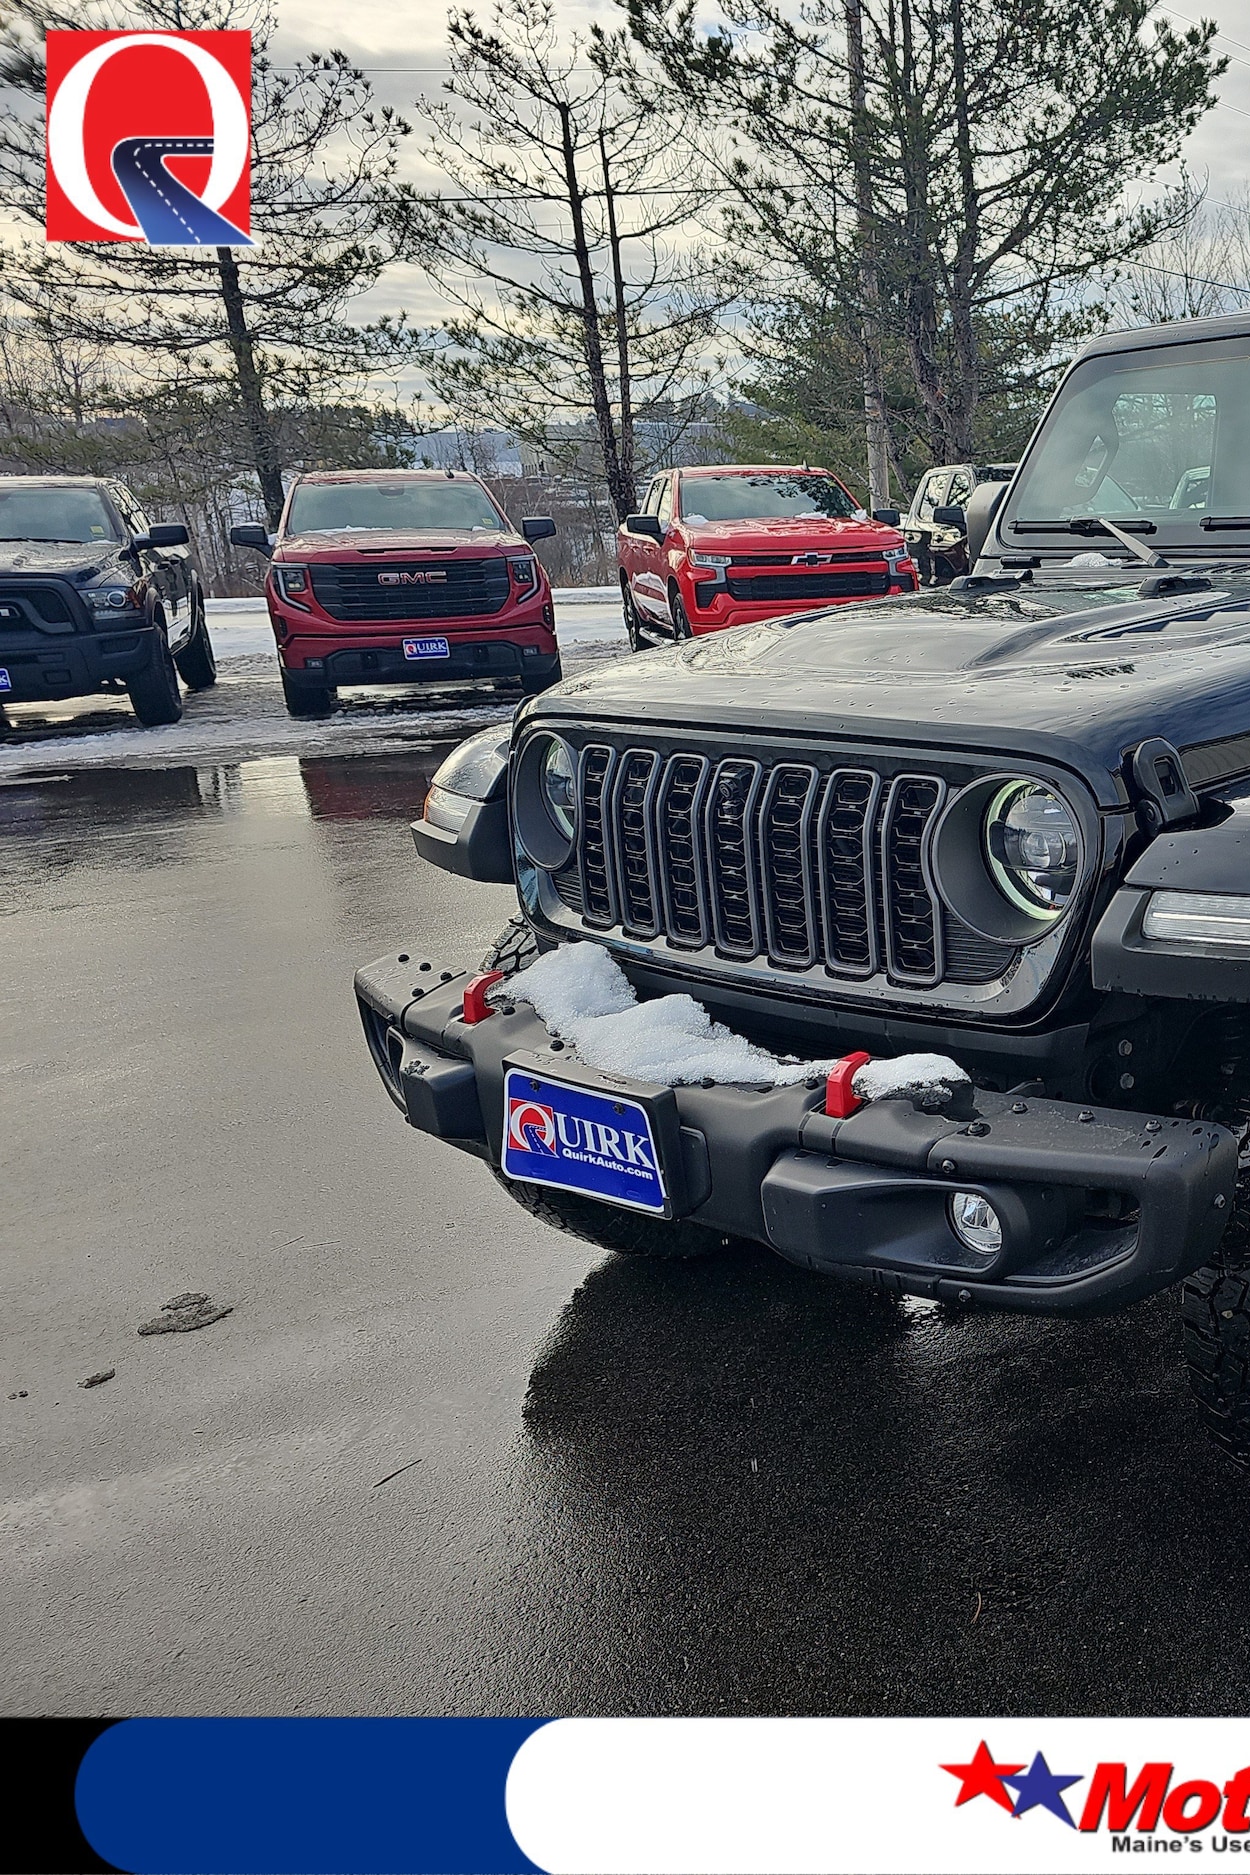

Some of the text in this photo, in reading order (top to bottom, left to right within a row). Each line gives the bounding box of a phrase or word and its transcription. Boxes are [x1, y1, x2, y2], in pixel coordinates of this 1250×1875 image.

[377, 571, 448, 586] GMC
[406, 641, 447, 655] QUIRK
[510, 1102, 656, 1170] QUIRK
[561, 1147, 654, 1181] QuirkAuto.com
